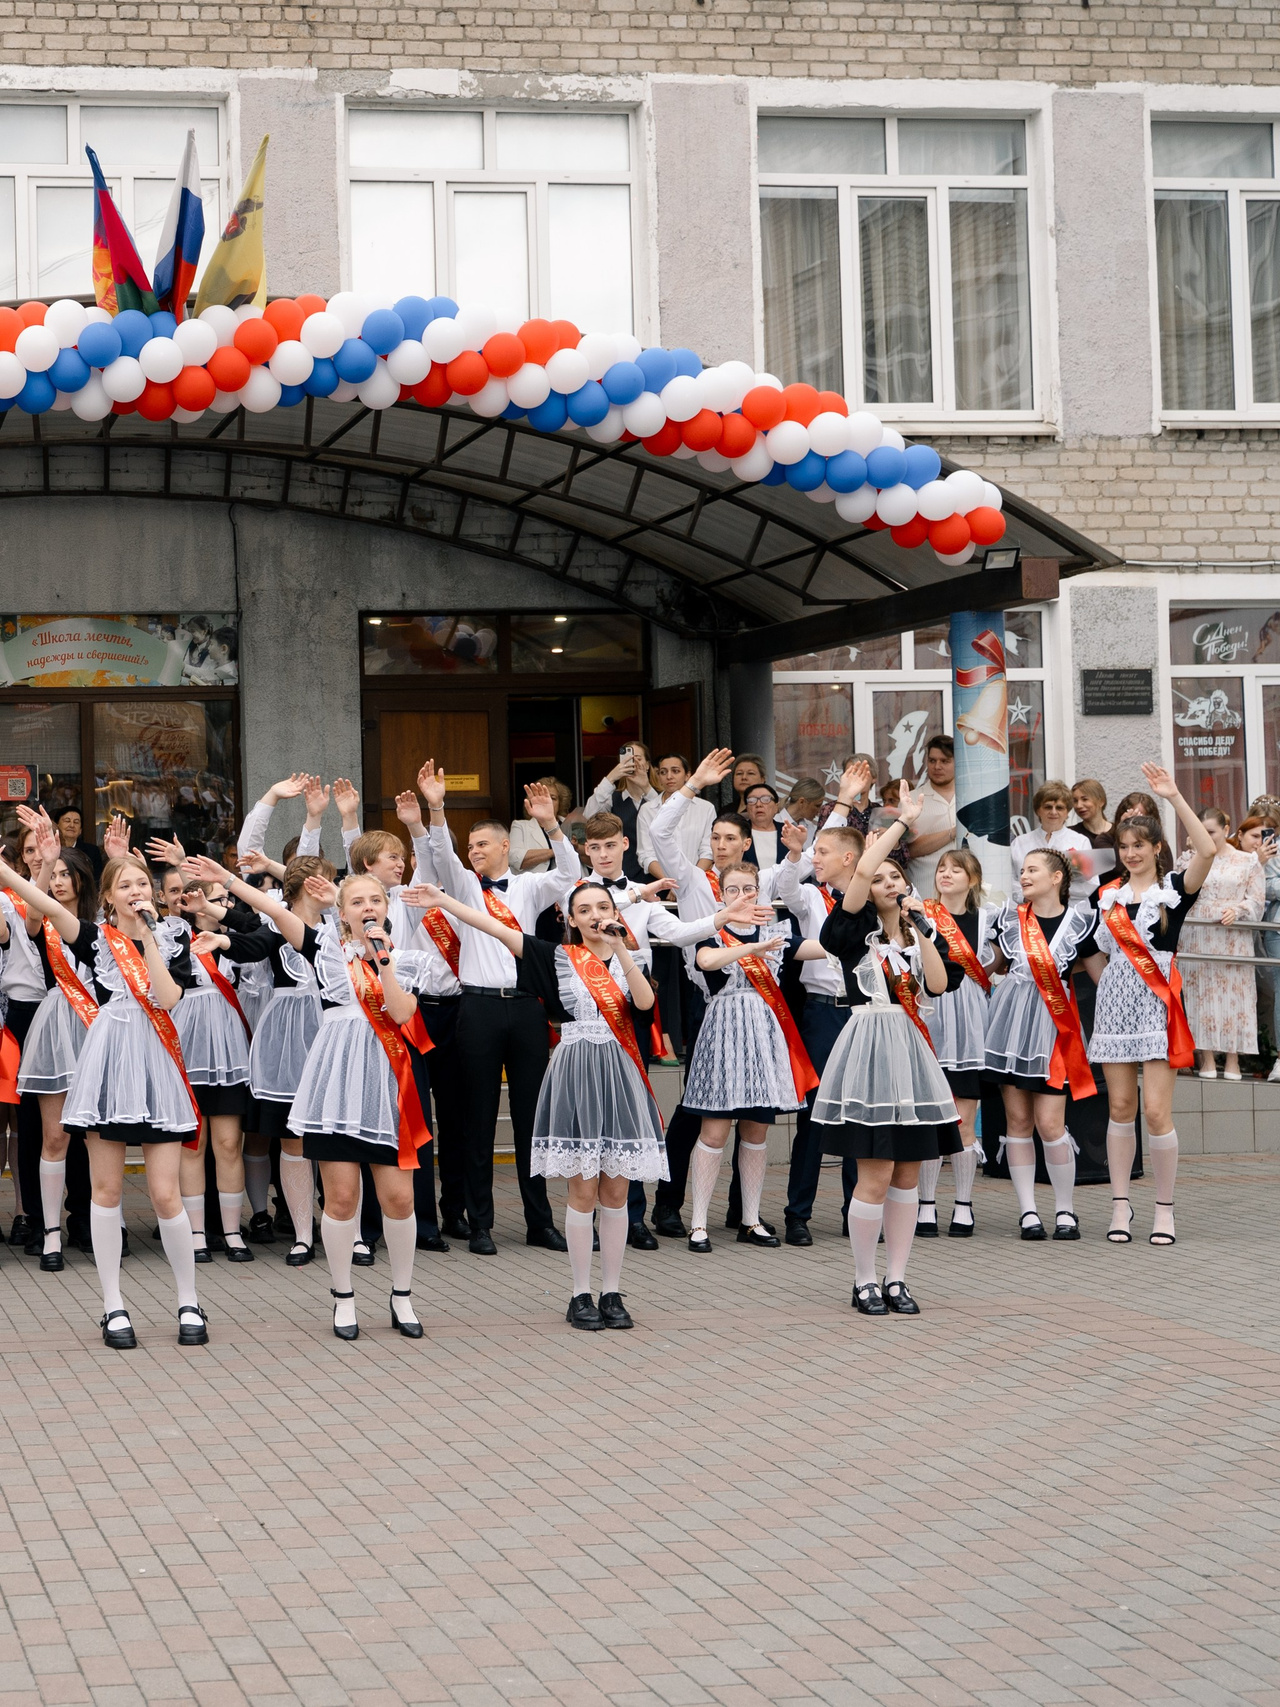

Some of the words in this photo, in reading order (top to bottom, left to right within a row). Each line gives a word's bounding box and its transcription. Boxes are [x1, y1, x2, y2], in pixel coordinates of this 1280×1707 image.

[31, 631, 81, 647] «Школа
[84, 631, 133, 648] мечты,
[1192, 623, 1211, 646] С
[1202, 632, 1249, 661] Победы!
[26, 651, 75, 669] надежды
[86, 649, 150, 666] свершений!»
[1178, 736, 1213, 746] СПАСИБО
[1214, 736, 1235, 746] ДЕДУ
[1184, 748, 1194, 756] ЗА
[1198, 747, 1231, 756] ПОБЕДУ!
[1047, 994, 1065, 1015] 2026
